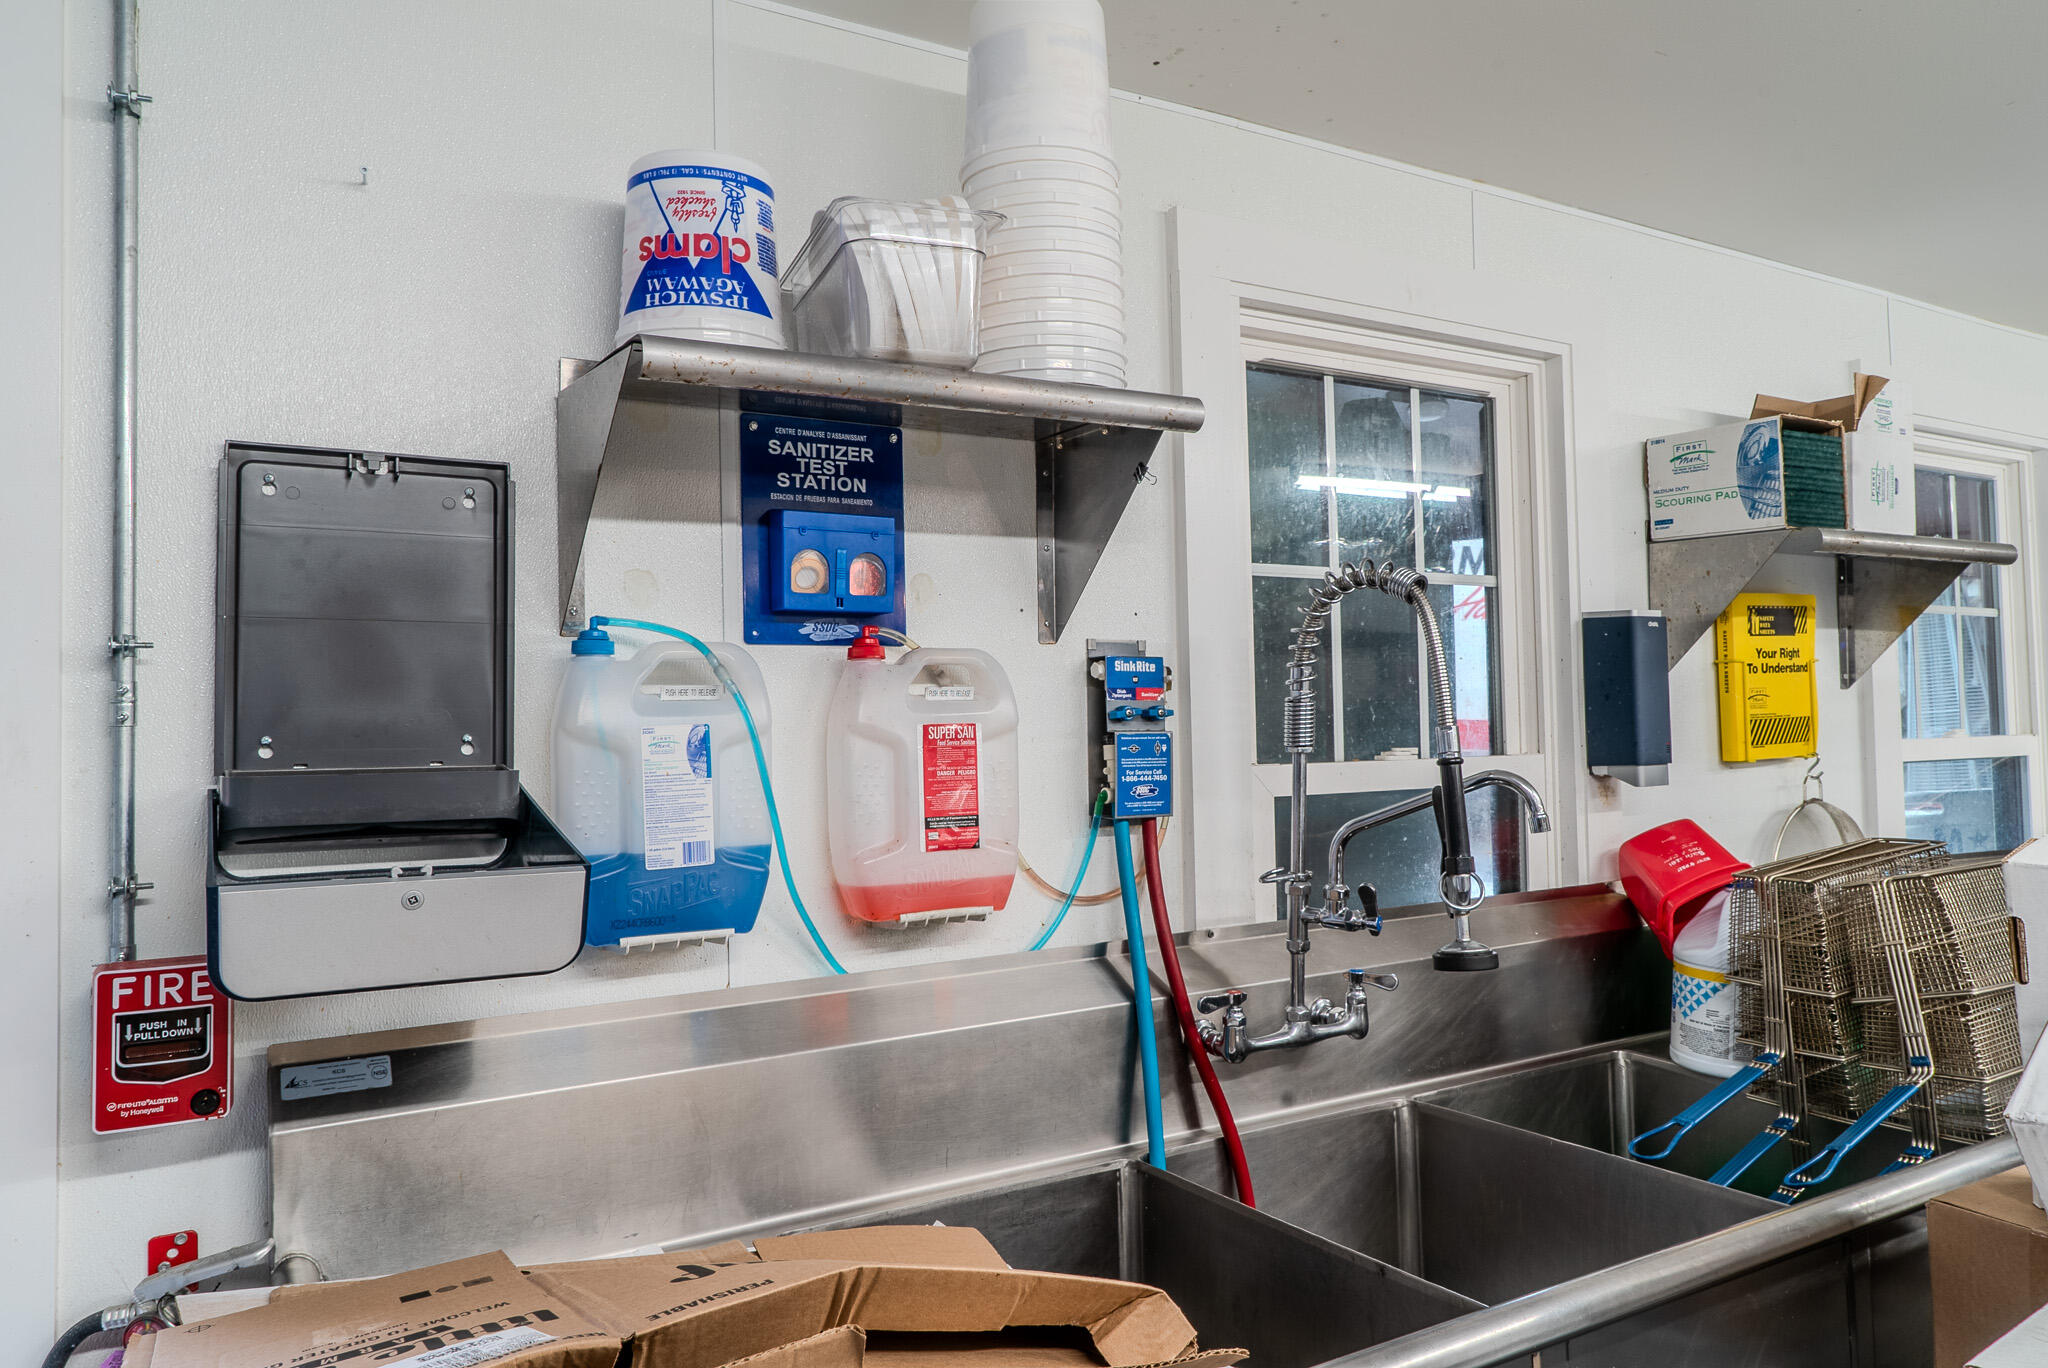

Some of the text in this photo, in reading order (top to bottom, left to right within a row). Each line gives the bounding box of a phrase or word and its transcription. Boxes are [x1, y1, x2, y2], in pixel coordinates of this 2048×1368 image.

[666, 196, 716, 210] shucked
[672, 206, 717, 222] freshly
[638, 233, 750, 274] clams
[646, 276, 745, 294] AGAWAM
[644, 290, 750, 310] IPSWICH
[775, 427, 796, 436] CENTRE
[798, 429, 825, 438] D'ANALYSE
[768, 440, 874, 462] SANITIZER
[1676, 444, 1702, 452] FIRST
[796, 458, 848, 476] TEST
[1679, 454, 1705, 465] Mark
[777, 472, 866, 493] STATION
[1655, 491, 1738, 508] SCOURING PAD
[812, 622, 839, 632] SSDC
[1756, 648, 1800, 660] Your Right
[1747, 662, 1808, 674] To Understand
[928, 726, 974, 740] SUPER SAN
[112, 970, 214, 1009] FIRE
[139, 1019, 188, 1031] PUSH IN
[134, 1028, 194, 1041] PULL DOWN
[130, 1105, 164, 1116] Honeywell
[646, 1278, 775, 1321] PERISHABLE
[418, 1302, 511, 1327] WELCOME
[386, 1327, 412, 1336] TO
[291, 1335, 381, 1363] GREATER
